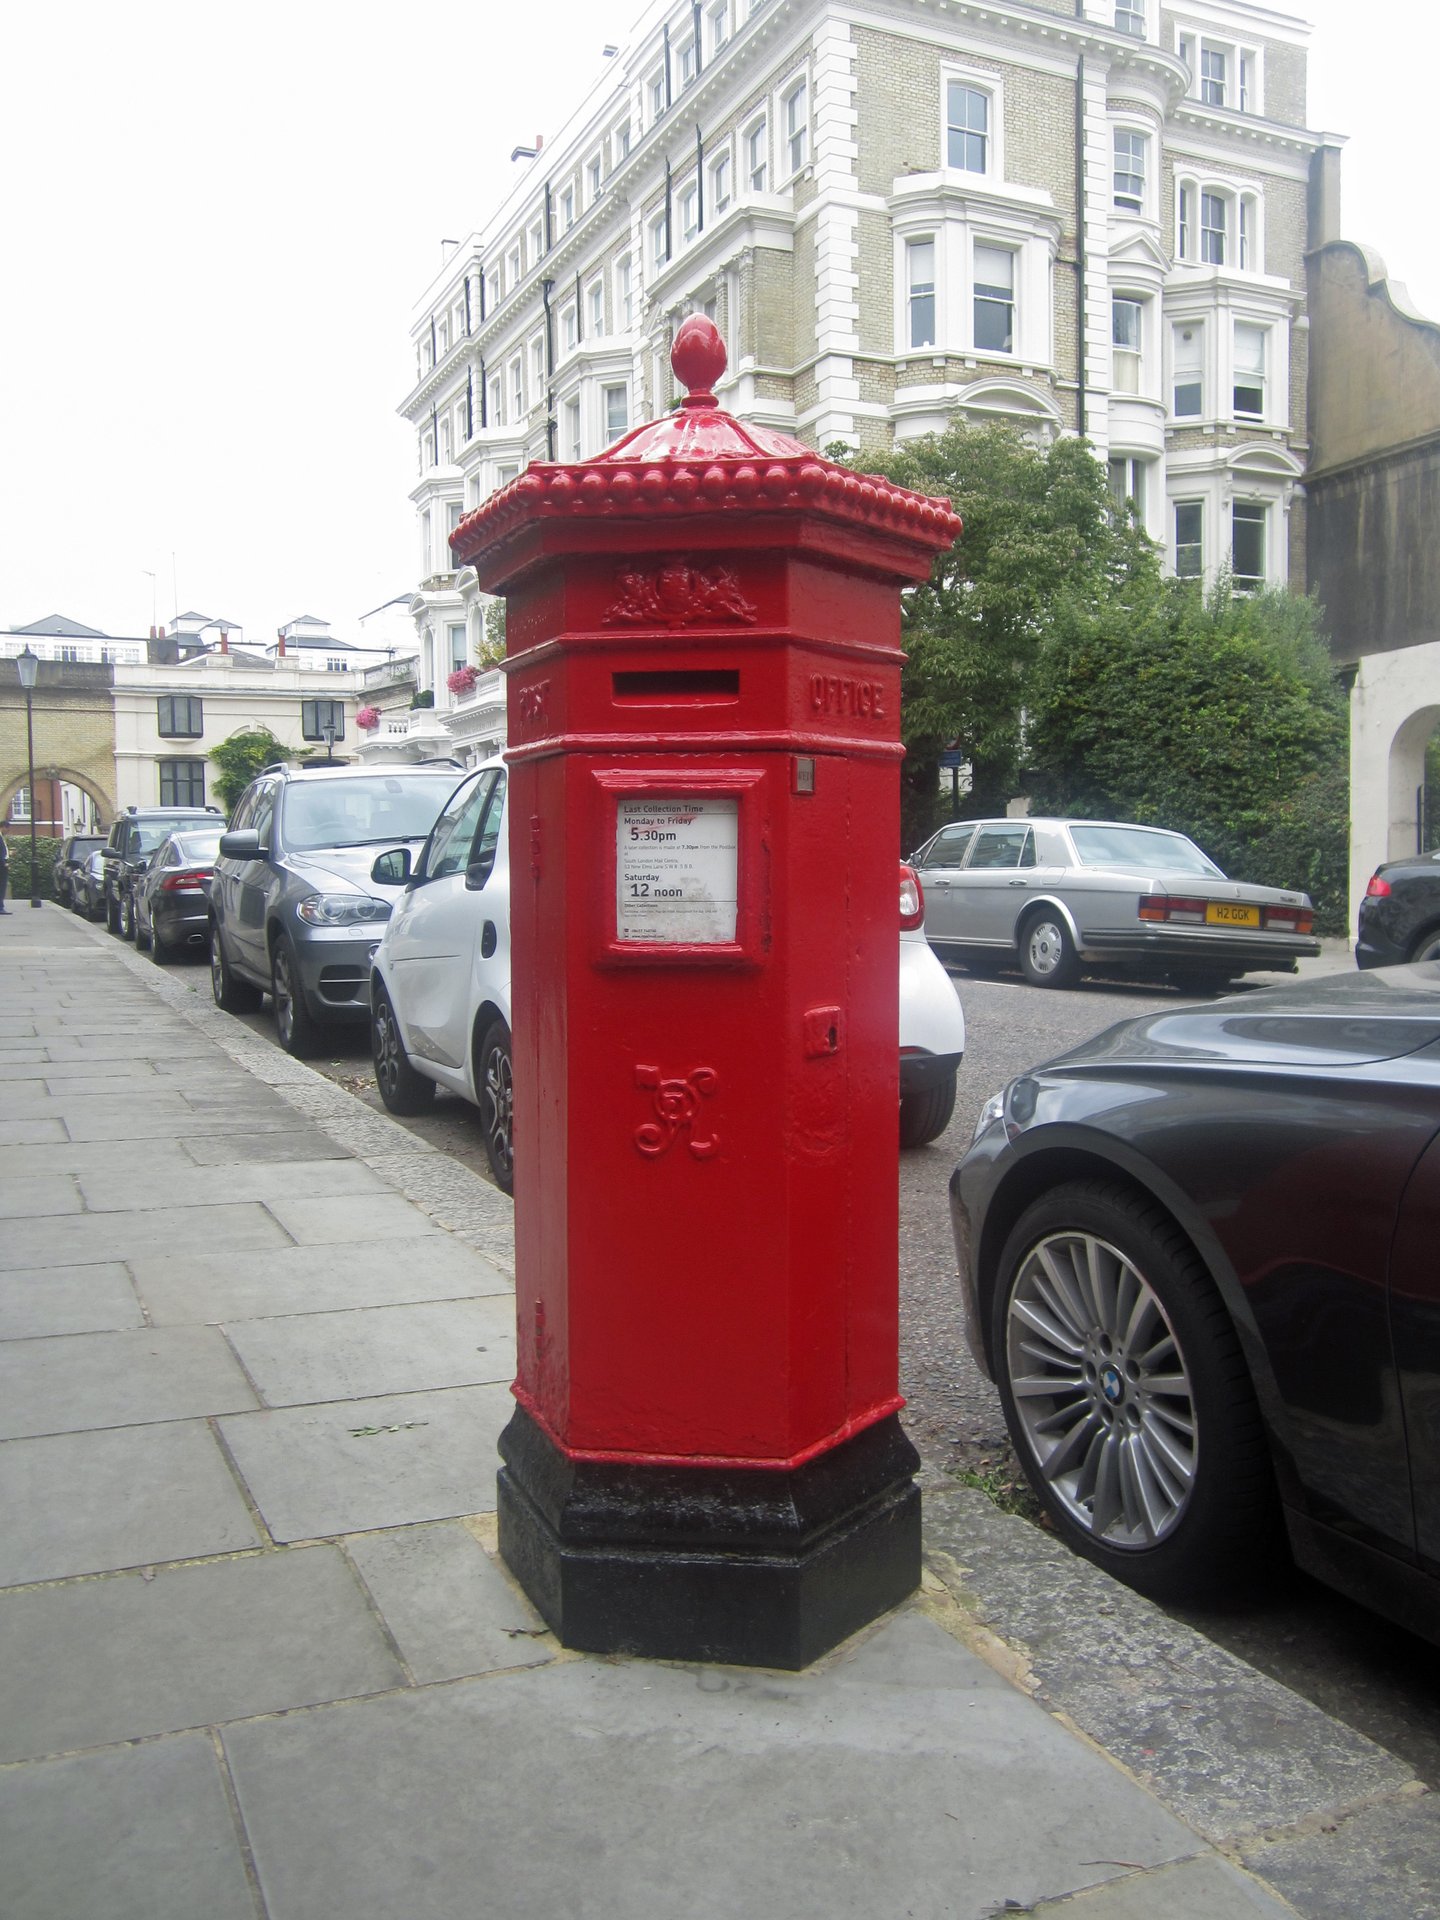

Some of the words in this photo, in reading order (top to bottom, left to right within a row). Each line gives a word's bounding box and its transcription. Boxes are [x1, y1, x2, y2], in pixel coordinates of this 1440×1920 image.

[810, 672, 885, 719] OFFICE
[624, 805, 641, 813] Last
[643, 805, 681, 813] Collection
[683, 805, 704, 813] Time
[624, 817, 654, 826] Monday
[667, 816, 692, 826] Friday
[630, 827, 677, 843] 5.30pm
[624, 873, 660, 882] Saturday
[630, 883, 650, 897] 12
[654, 888, 683, 897] noon
[1217, 907, 1230, 919] H2
[1231, 908, 1250, 920] GGK
